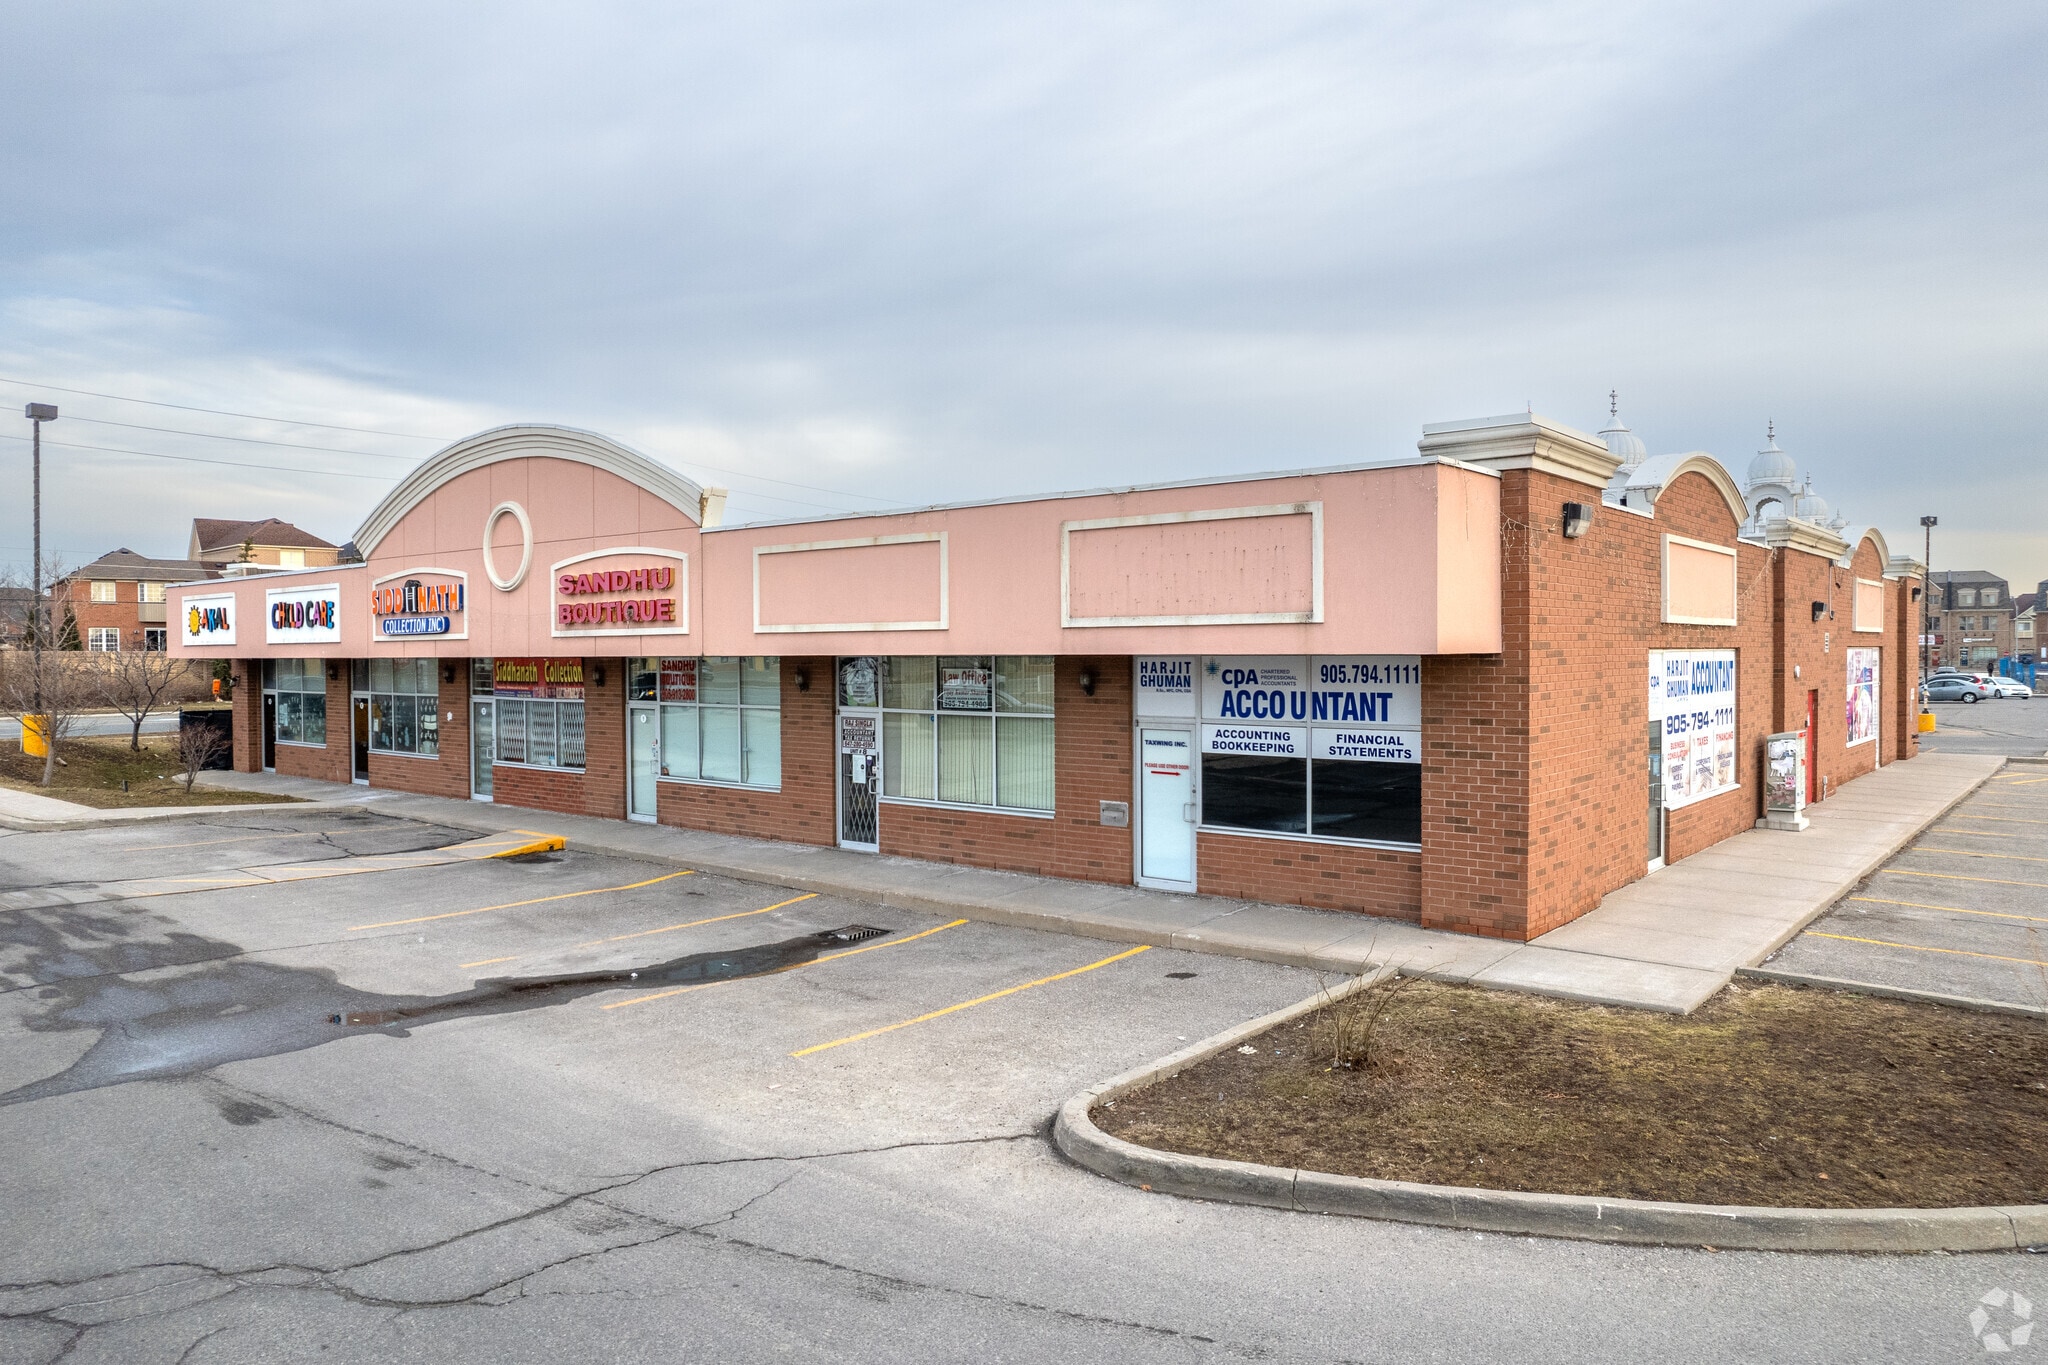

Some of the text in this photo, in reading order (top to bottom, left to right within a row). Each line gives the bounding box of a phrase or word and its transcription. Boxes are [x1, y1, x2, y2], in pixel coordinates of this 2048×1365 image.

[558, 567, 673, 595] SANDHU
[201, 607, 229, 632] AKAL
[271, 600, 335, 629] CHILD CARE
[558, 599, 674, 625] BOUTIQUE
[385, 617, 442, 633] COLLECTION INC
[495, 660, 584, 683] Siddhanath Collection
[661, 660, 696, 671] SANDHU
[1140, 661, 1191, 674] HARJIT
[1320, 664, 1419, 684] 905.794.1111
[943, 670, 987, 684] Law Office
[1140, 675, 1191, 688] GHUMAN
[1666, 659, 1734, 695] HARJIT ACCOUNTANT
[1666, 679, 1689, 698] GHUMAN
[1221, 690, 1393, 722] ACCOUNTANT
[1215, 729, 1291, 741] ACCOUNTING
[1336, 734, 1404, 746] FINANCIAL
[1212, 741, 1295, 753] BOOKKEEPING
[1328, 746, 1412, 759] STATEMENTS
